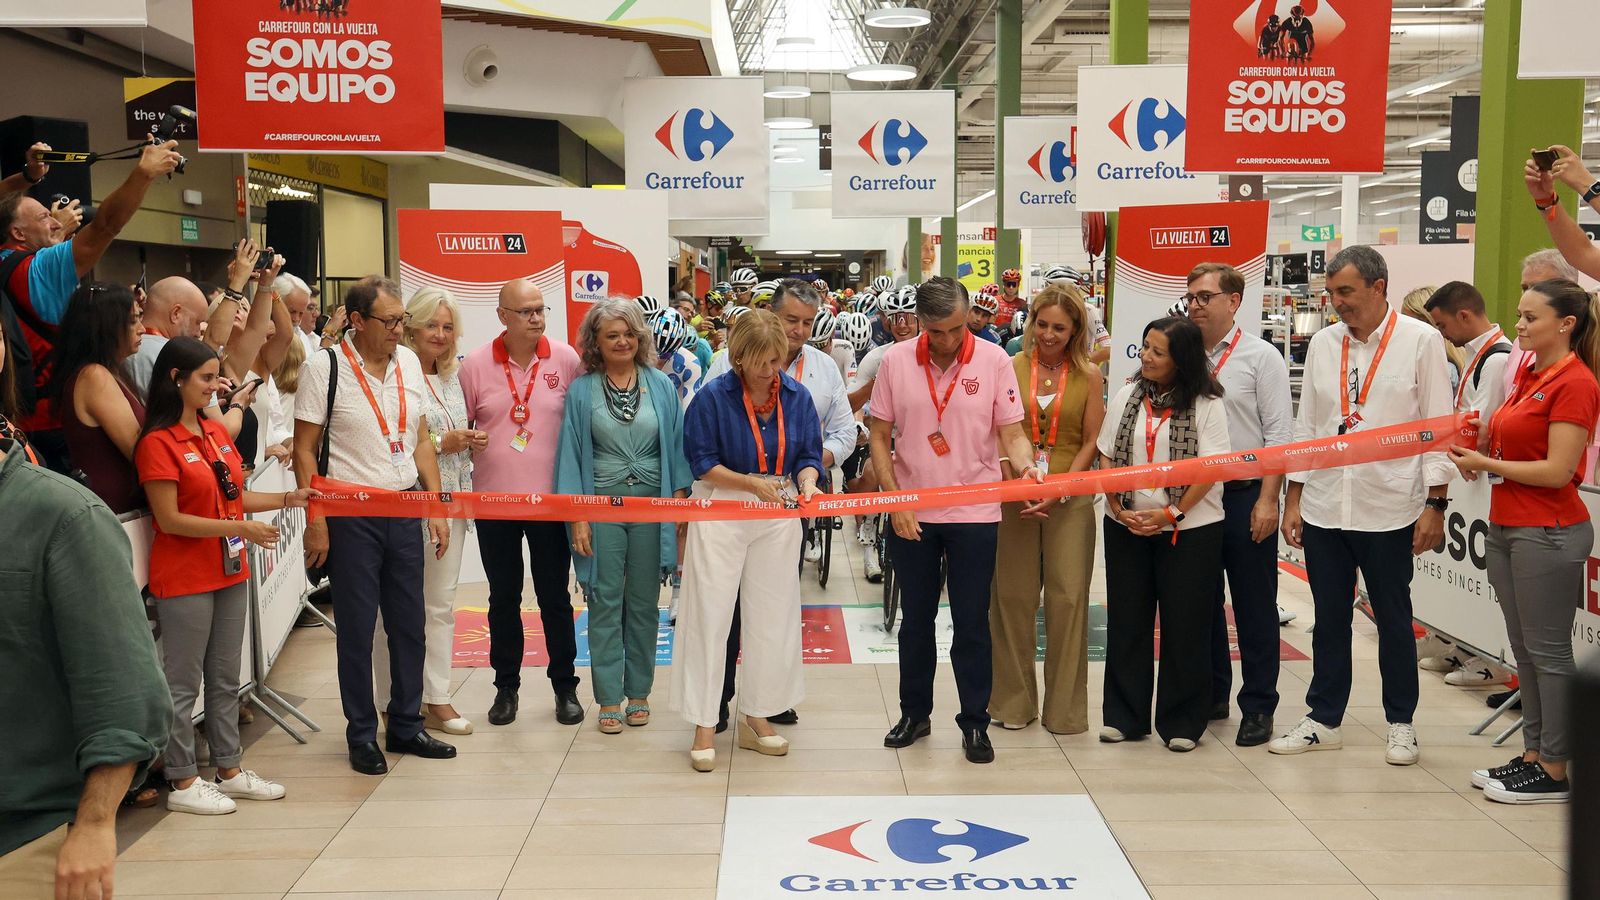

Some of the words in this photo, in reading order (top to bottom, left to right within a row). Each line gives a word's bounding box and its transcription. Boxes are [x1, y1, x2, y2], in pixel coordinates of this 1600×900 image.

[258, 20, 311, 34] CARREFOUR
[313, 22, 330, 34] CON
[333, 22, 344, 35] LA
[346, 23, 378, 35] VUELTA
[246, 37, 393, 70] SOMOS
[1239, 66, 1281, 76] CARREFOUR
[1282, 66, 1298, 76] CON
[1300, 66, 1308, 76] LA
[1310, 66, 1335, 76] VUELTA
[244, 72, 396, 104] EQUIPO
[1227, 80, 1346, 105] SOMOS
[134, 109, 155, 121] the
[1224, 108, 1346, 133] EQUIPO
[264, 133, 381, 142] #CARREFOURCONLAVUELTA
[645, 172, 744, 190] Carrefour
[849, 174, 937, 190] Carrefour
[1019, 190, 1076, 204] Carrefo
[445, 237, 459, 250] LA
[460, 237, 501, 250] VUELTA
[507, 237, 522, 250] 24
[1156, 232, 1168, 244] LA
[1169, 230, 1206, 244] VUELTA
[1212, 230, 1226, 243] 24
[977, 259, 990, 277] 3
[1314, 255, 1320, 269] 5
[1381, 437, 1390, 445] LA
[1391, 434, 1418, 444] VUELTA
[1422, 432, 1431, 441] 24
[1284, 444, 1328, 456] Carrefour
[1214, 456, 1241, 465] VUELTA
[412, 493, 438, 501] VUELTA
[480, 494, 522, 503] Carrefour
[574, 497, 583, 505] LA
[583, 496, 609, 505] VUELTA
[612, 497, 622, 505] 24
[651, 498, 692, 507] Carrefour
[818, 499, 844, 511] JEREZ
[846, 498, 859, 508] DE
[860, 497, 871, 507] LA
[873, 493, 919, 506] FRONTERA
[744, 501, 753, 509] LA
[753, 501, 781, 510] VUELTA
[1447, 570, 1481, 596] SINCE
[780, 872, 1077, 893] Carrefour
